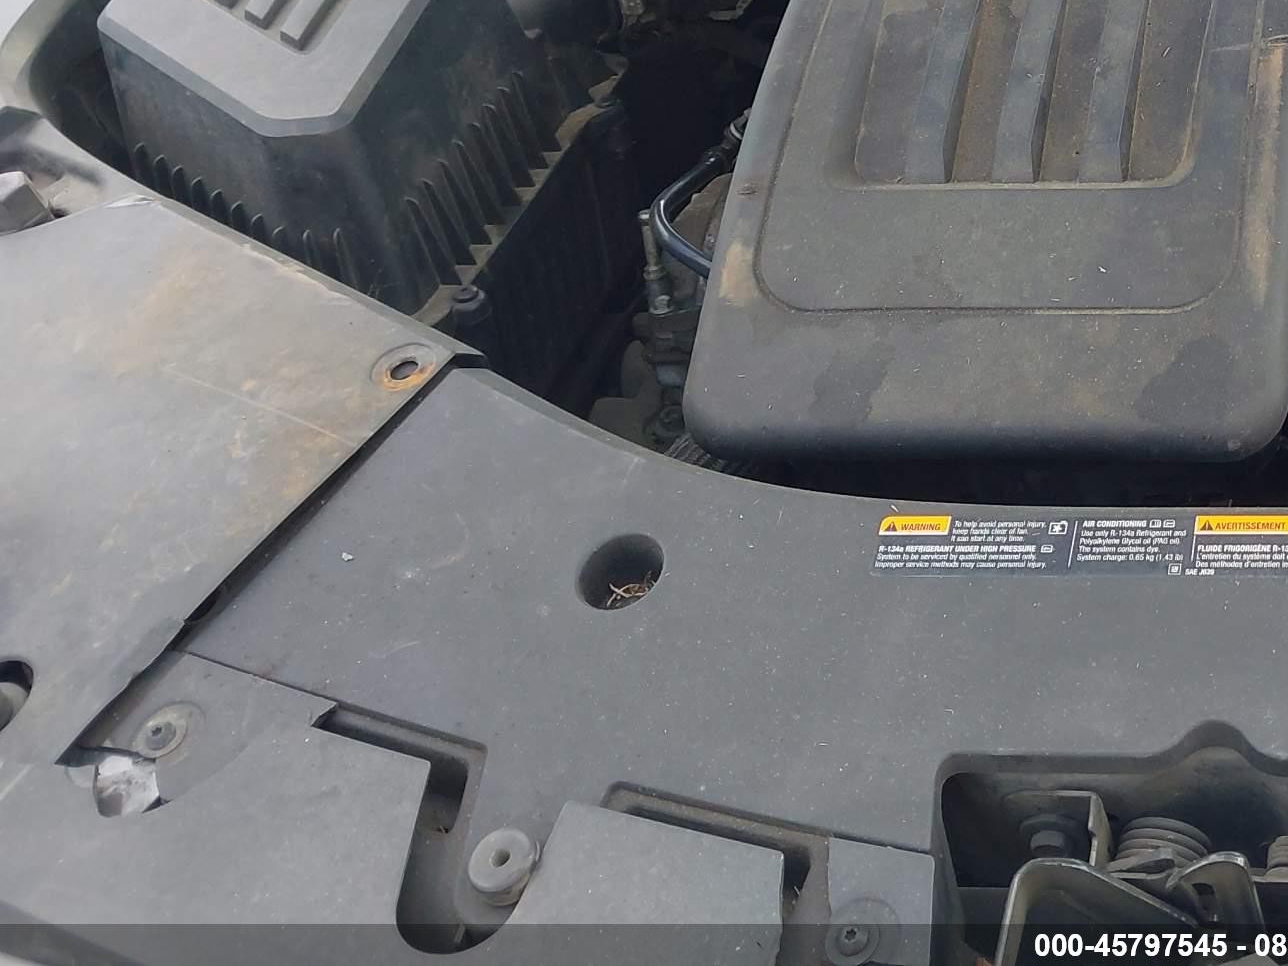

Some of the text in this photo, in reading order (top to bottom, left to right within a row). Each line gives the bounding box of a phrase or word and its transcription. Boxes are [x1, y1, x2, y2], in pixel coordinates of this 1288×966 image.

[901, 523, 941, 531] WARNING
[1096, 520, 1147, 528] CONDITIONING
[1215, 522, 1286, 531] AVERTISSEMENT
[1095, 530, 1109, 538] only
[1110, 530, 1134, 538] R-134a
[1136, 530, 1171, 538] Refrigerant
[1173, 530, 1187, 538] and
[879, 545, 1037, 553] R-134a REFRIGERANT UNDER HIGH PRESSURE
[1092, 545, 1116, 554] system
[1117, 545, 1145, 554] contains
[1146, 545, 1161, 554] dye.
[1198, 544, 1223, 552] FLUIDE
[1077, 553, 1100, 562] System
[1102, 553, 1128, 562] charge:
[1129, 553, 1144, 562] 0.65
[1156, 553, 1174, 562] (1.43
